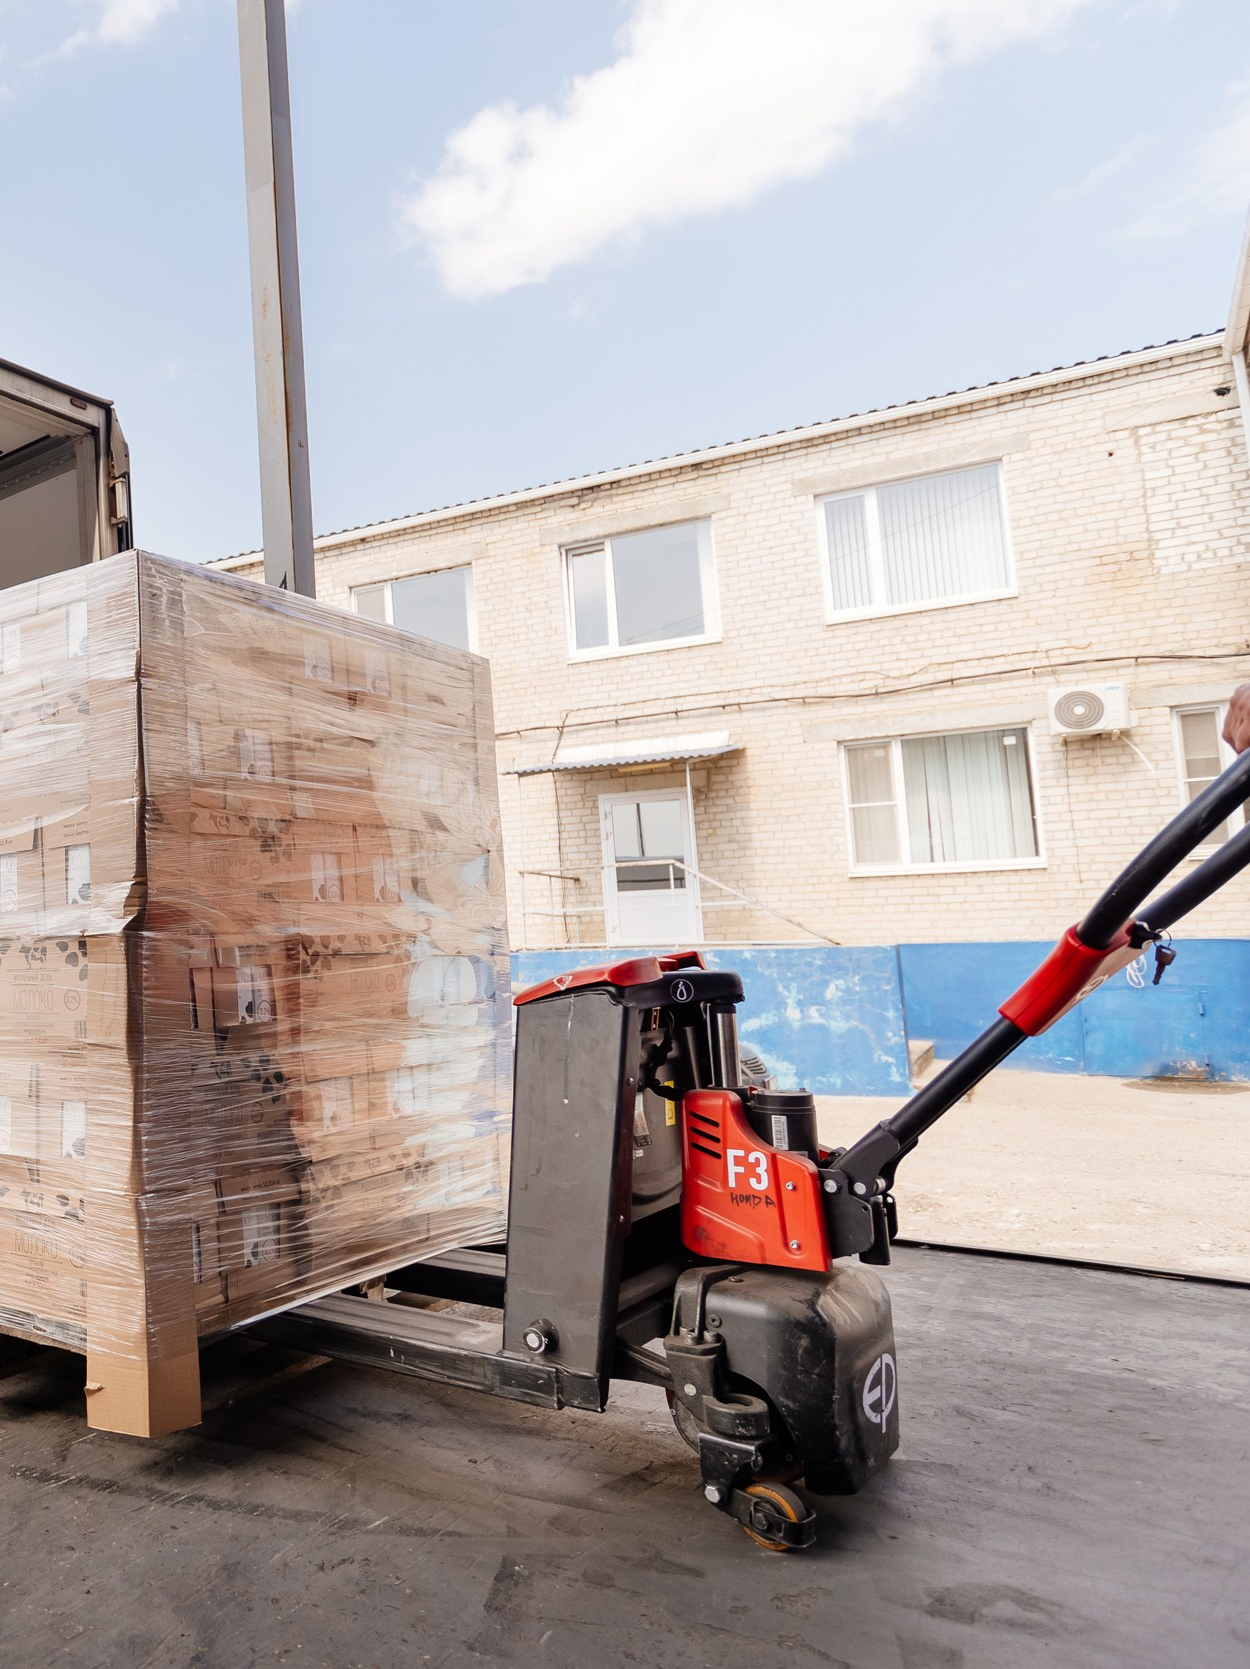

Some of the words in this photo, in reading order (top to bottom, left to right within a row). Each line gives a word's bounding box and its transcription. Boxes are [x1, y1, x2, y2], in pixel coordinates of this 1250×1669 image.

[14, 973, 38, 982] МОЛОЧНЫЙ
[39, 973, 53, 982] ДЕНЬ
[13, 989, 54, 1011] МОЛОКО
[726, 1148, 769, 1191] F3
